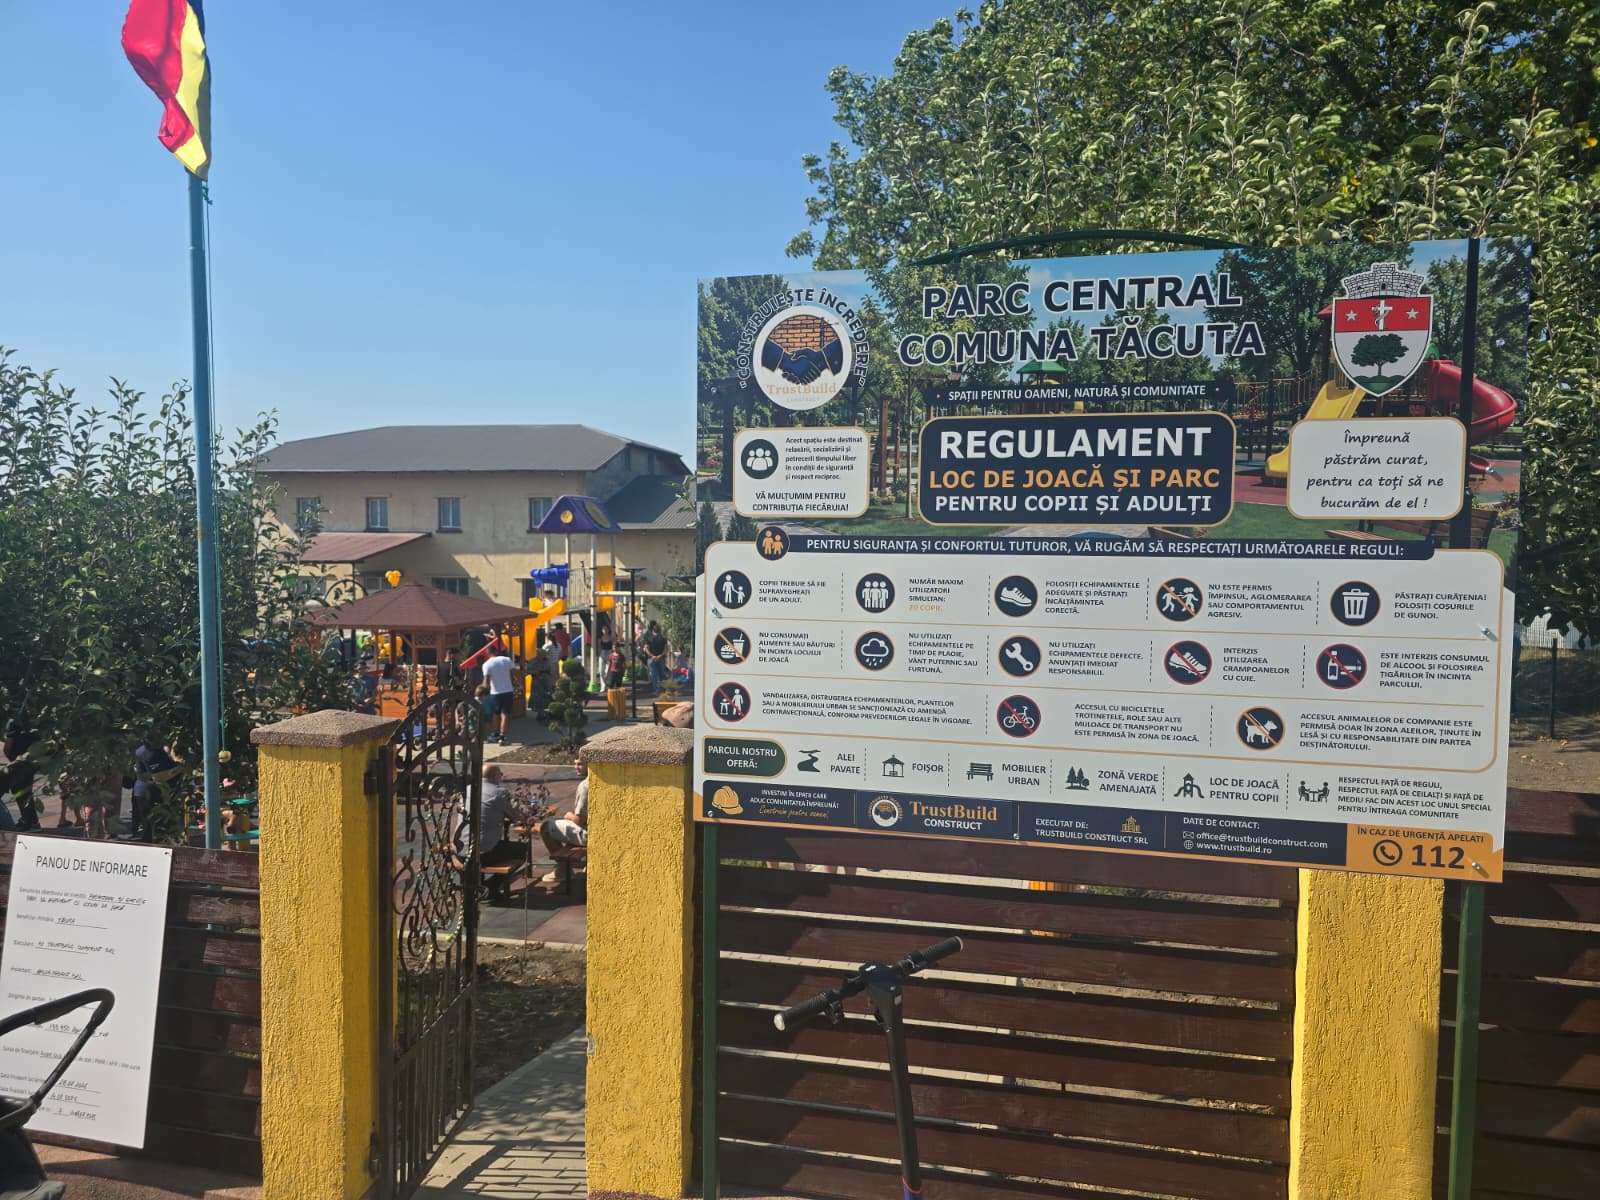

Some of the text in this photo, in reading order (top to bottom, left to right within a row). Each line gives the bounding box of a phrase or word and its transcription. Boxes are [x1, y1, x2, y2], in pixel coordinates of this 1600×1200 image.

[922, 273, 1242, 319] PARC CENTRAL
[900, 316, 1265, 366] COMUNA TĂCUTA
[767, 382, 837, 395] TrustBuild
[948, 384, 1205, 403] SPAȚII PENTRU OAMENI, NATURĂ ȘI COMUNITATE
[940, 427, 1212, 460] REGULAMENT
[1343, 429, 1411, 447] Împreună
[1324, 454, 1427, 467] păstrăm curat,
[930, 464, 1219, 492] LOC DE JOACĂ ȘI PARC
[1306, 476, 1352, 490] pentru
[1358, 479, 1372, 487] ca
[1408, 476, 1421, 487] să
[1427, 479, 1443, 487] ne
[755, 490, 765, 499] VĂ
[768, 492, 812, 501] MULȚUMIM
[752, 504, 803, 512] CONTRIBUȚIA
[935, 496, 1210, 514] PENTRU COPII ȘI ADULȚI
[1320, 497, 1379, 508] bucurăm
[1385, 497, 1401, 508] de
[1406, 497, 1418, 508] el
[806, 539, 1403, 556] PENTRU SIGURANȚA ȘI CONFORTUL TUTUROR, VĂ RUGĂM SĂ RESPECTAȚI URMĂTOARELE REGULI:
[1208, 591, 1248, 602] ÎMPINSUL,
[1394, 591, 1433, 602] PĂSTRAȚI
[1225, 602, 1304, 611] COMPORTAMENTUL
[1394, 602, 1430, 612] FOLOSIȚI
[1223, 656, 1267, 664] UTILIZAREA
[1401, 653, 1437, 661] INTERZIS
[1440, 654, 1489, 662] CONSUMUL
[1426, 671, 1434, 680] ÎN
[1437, 673, 1471, 681] INCINTA
[1379, 681, 1421, 689] PARCULUI.
[1300, 713, 1472, 727] ACCESUL ANIMALELOR DE COMPANIE ESTE
[1338, 724, 1361, 732] DOAR
[1364, 723, 1372, 733] ÎN
[1374, 726, 1398, 734] ZONA
[1472, 728, 1480, 737] ÎN
[708, 746, 776, 757] PARCUL NOSTRU
[836, 753, 854, 762] ALEI
[830, 765, 860, 774] PAVATE
[912, 763, 943, 775] FOIȘOR
[1002, 763, 1046, 774] MOBILIER
[1098, 767, 1158, 782] ZONĂ VERDE
[1008, 776, 1039, 786] URBAN
[1099, 780, 1156, 795] AMENAJATĂ
[1209, 776, 1279, 789] LOC DE JOACĂ
[1338, 776, 1442, 791] RESPECTUL FAȚĂ DE REGULI,
[1210, 790, 1278, 802] PENTRU COPII
[1338, 795, 1491, 811] MEDIU FAC DIN ACEST LOC UNUL SPECIAL
[909, 801, 998, 821] TrustBuild
[1337, 805, 1367, 814] PENTRU
[1408, 809, 1458, 819] COMUNITATE
[924, 818, 982, 830] CONSTRUCT
[1035, 818, 1072, 828] EXECUTAT
[1183, 817, 1203, 826] DATE
[1218, 820, 1259, 829] CONTACT:
[1035, 829, 1148, 844] TRUSTBUILD CONSTRUCT SRL
[1196, 832, 1328, 849] office@trustbuildconstruct.com
[1357, 826, 1366, 836] ÎN
[1369, 829, 1386, 837] CAZ
[1402, 829, 1445, 842] URGENȚĂ
[1411, 845, 1465, 869] 112
[36, 855, 148, 878] PANOU DE INFORMARE
